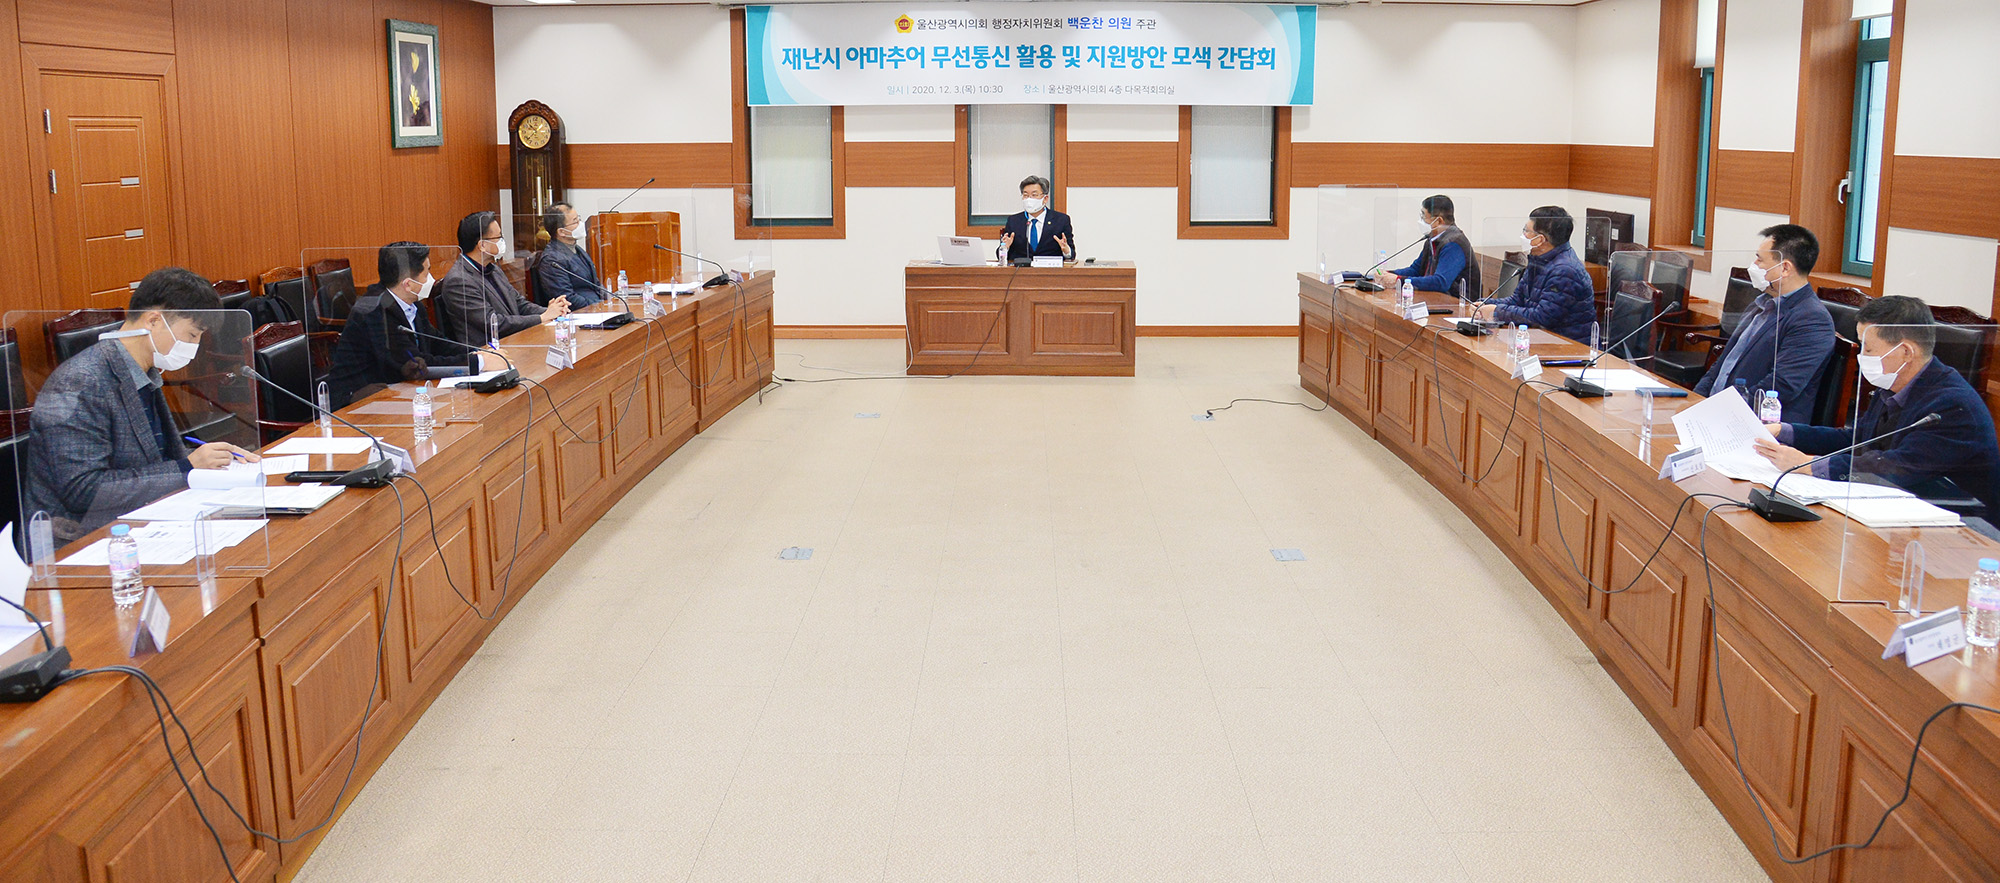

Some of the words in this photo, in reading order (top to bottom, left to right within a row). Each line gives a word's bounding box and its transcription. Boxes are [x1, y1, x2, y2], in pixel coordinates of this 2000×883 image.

[916, 18, 988, 30] 울산광역시의회
[991, 17, 1063, 30] 행정자치위원회
[1067, 16, 1104, 30] 백운찬
[1108, 16, 1132, 30] 의원
[1135, 18, 1157, 30] 주관
[781, 47, 841, 71] 재난시
[845, 45, 926, 70] 아마추어
[930, 45, 1011, 70] 무선통신
[1015, 43, 1057, 70] 활용
[1061, 45, 1081, 69] 및
[1086, 44, 1168, 70] 지원방안
[1171, 46, 1212, 70] 모색
[1217, 46, 1276, 71] 간담회
[886, 85, 904, 95] 일시
[912, 85, 936, 94] 2020.
[939, 85, 952, 94] 12.
[954, 84, 976, 95] 3.(목)
[979, 84, 1004, 94] 10:30
[1023, 84, 1040, 95] 장소
[1048, 84, 1107, 95] 울산광역시의회
[1108, 84, 1123, 95] 4층
[1124, 84, 1175, 96] 다목적회의실
